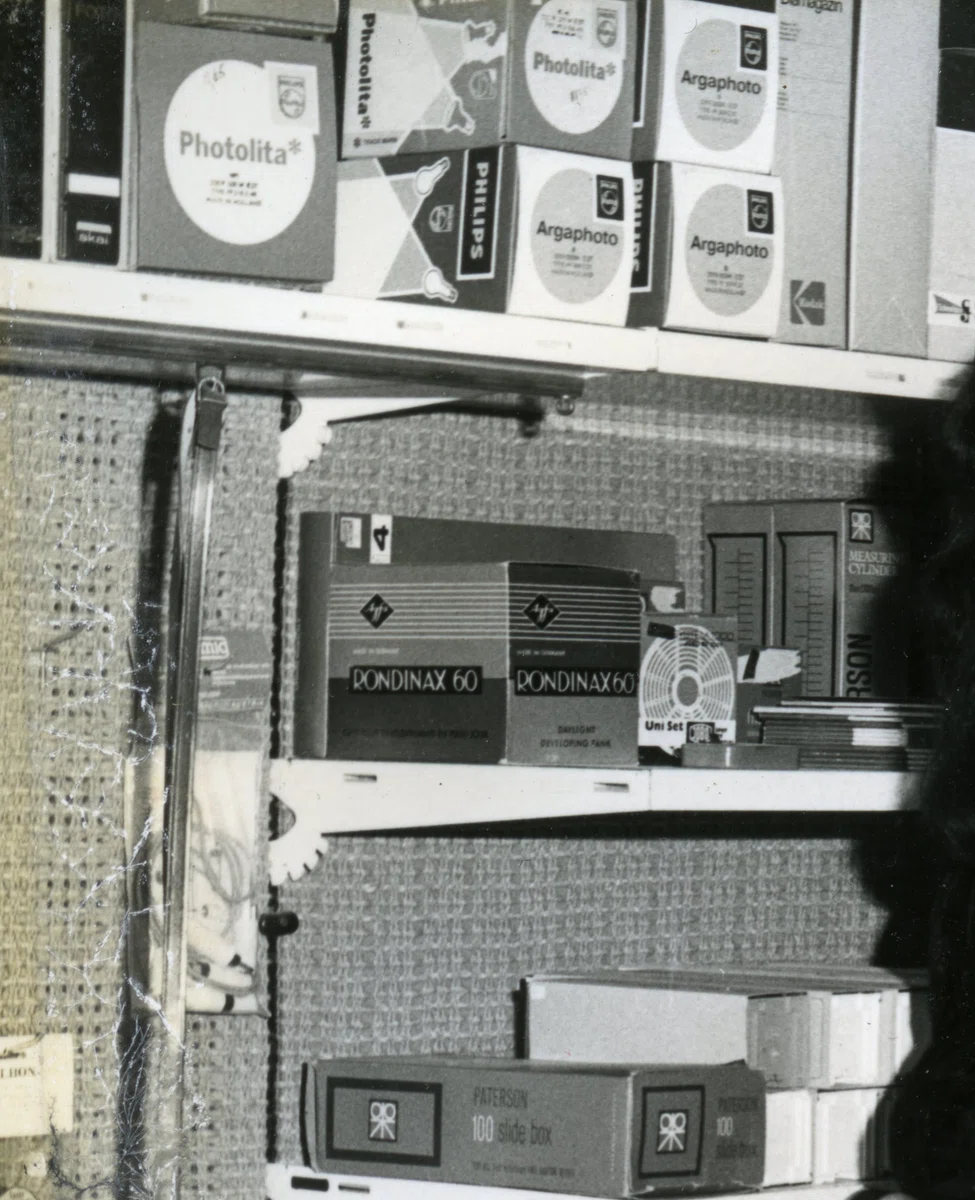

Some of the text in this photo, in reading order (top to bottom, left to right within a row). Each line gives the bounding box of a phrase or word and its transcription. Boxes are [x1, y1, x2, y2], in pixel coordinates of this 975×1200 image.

[681, 69, 762, 95] Argaphoto
[470, 162, 489, 260] PHILIPS
[536, 220, 619, 246] Argaphoto
[690, 235, 769, 259] Argaphoto
[353, 668, 479, 693] RONDINAX 60
[517, 669, 636, 693] RONDINAX 60
[645, 720, 684, 731] Uni Set
[473, 1086, 529, 1110] PATERSON
[472, 1115, 553, 1146] 100 slide box
[716, 1116, 734, 1137] 100
